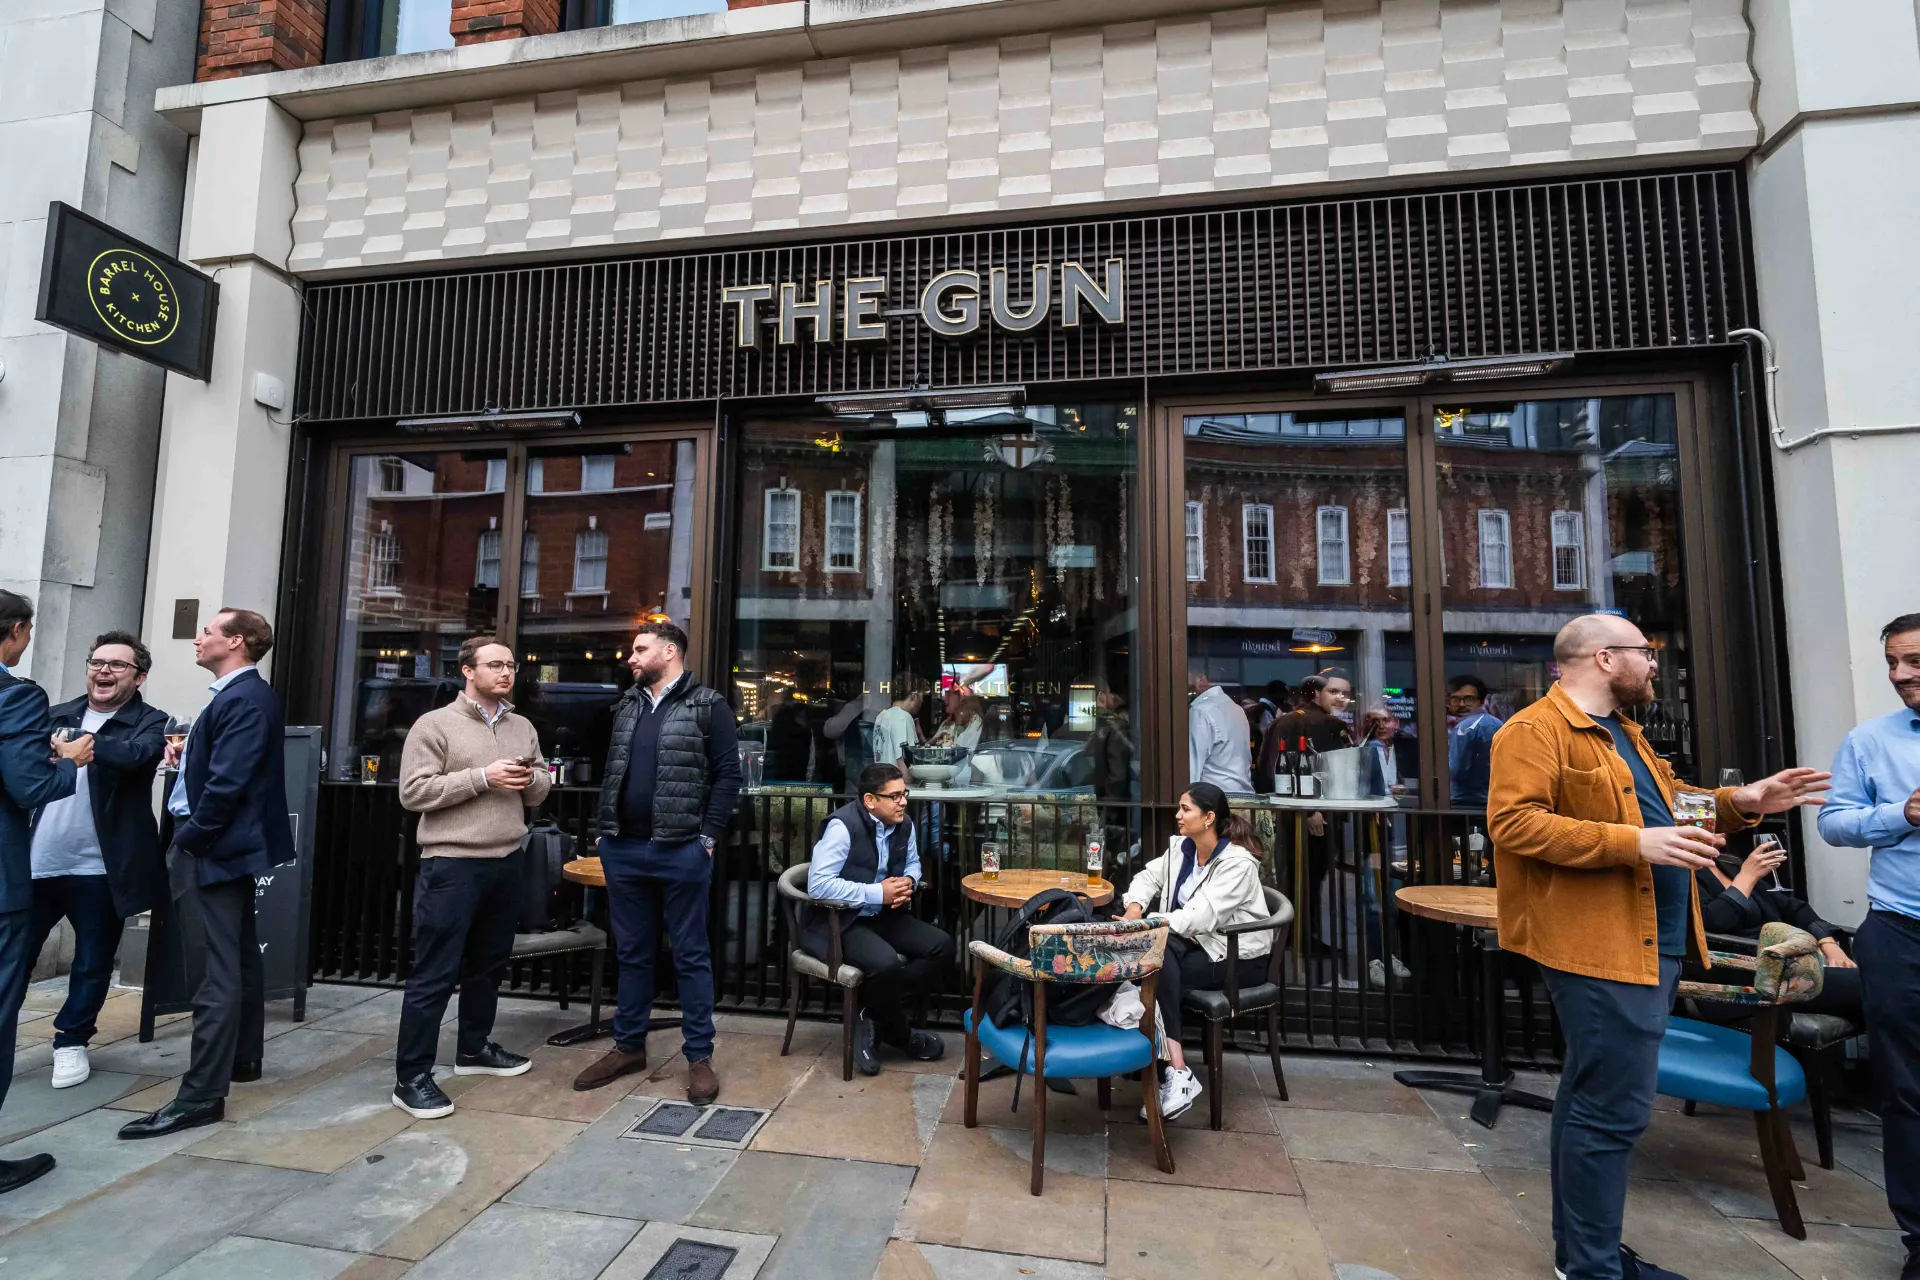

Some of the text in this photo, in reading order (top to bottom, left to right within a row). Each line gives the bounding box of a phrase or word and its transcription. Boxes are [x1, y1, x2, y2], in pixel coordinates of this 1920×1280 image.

[100, 260, 170, 321] BARREL HOUSE
[722, 257, 1125, 349] THE GUN
[106, 303, 160, 333] KITCHEN
[974, 681, 1062, 695] KITCHEN
